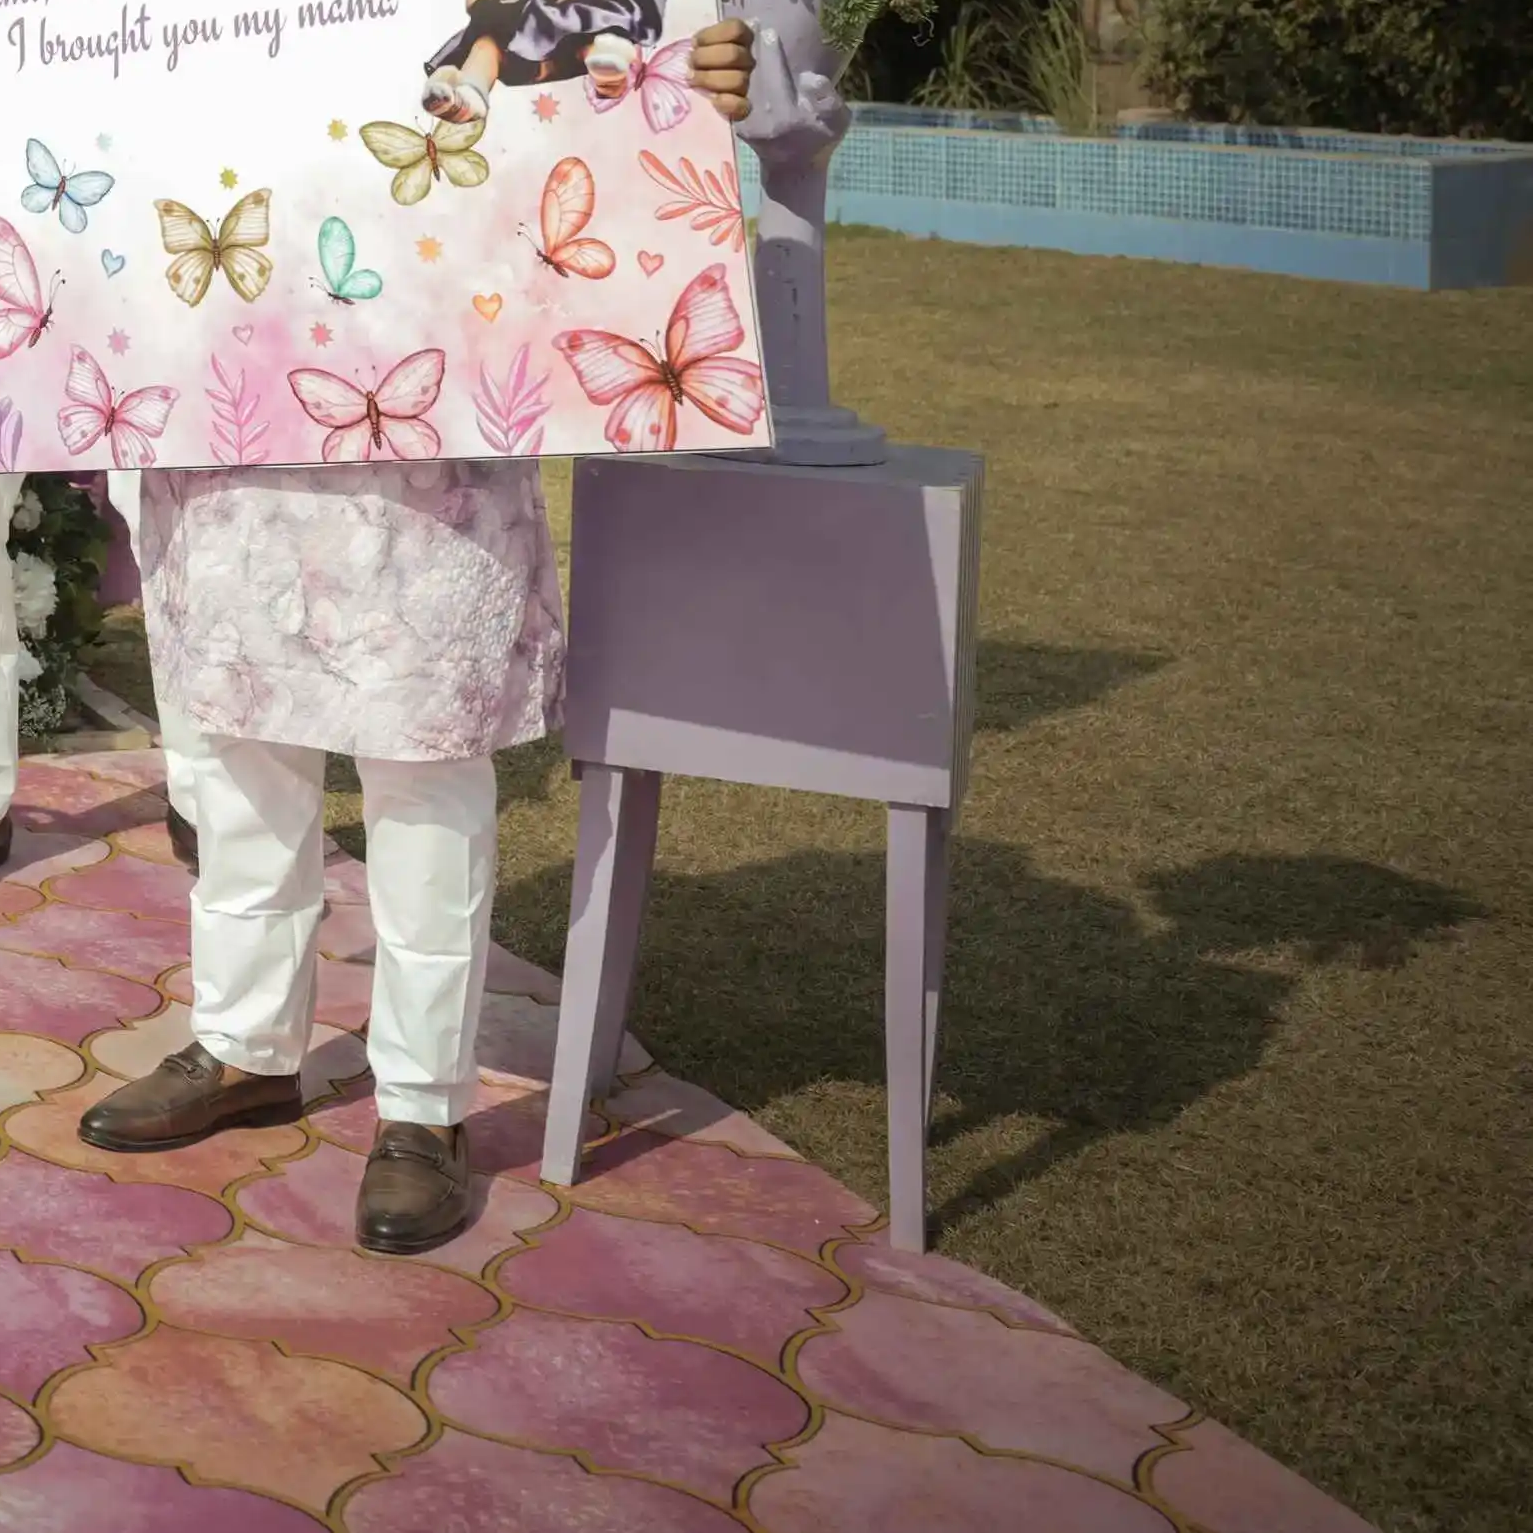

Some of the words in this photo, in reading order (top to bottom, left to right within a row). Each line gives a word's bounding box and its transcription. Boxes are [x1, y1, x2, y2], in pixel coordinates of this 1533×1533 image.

[8, 17, 25, 72] I
[40, 4, 151, 79] brought
[163, 18, 222, 72] you
[234, 9, 286, 58] my
